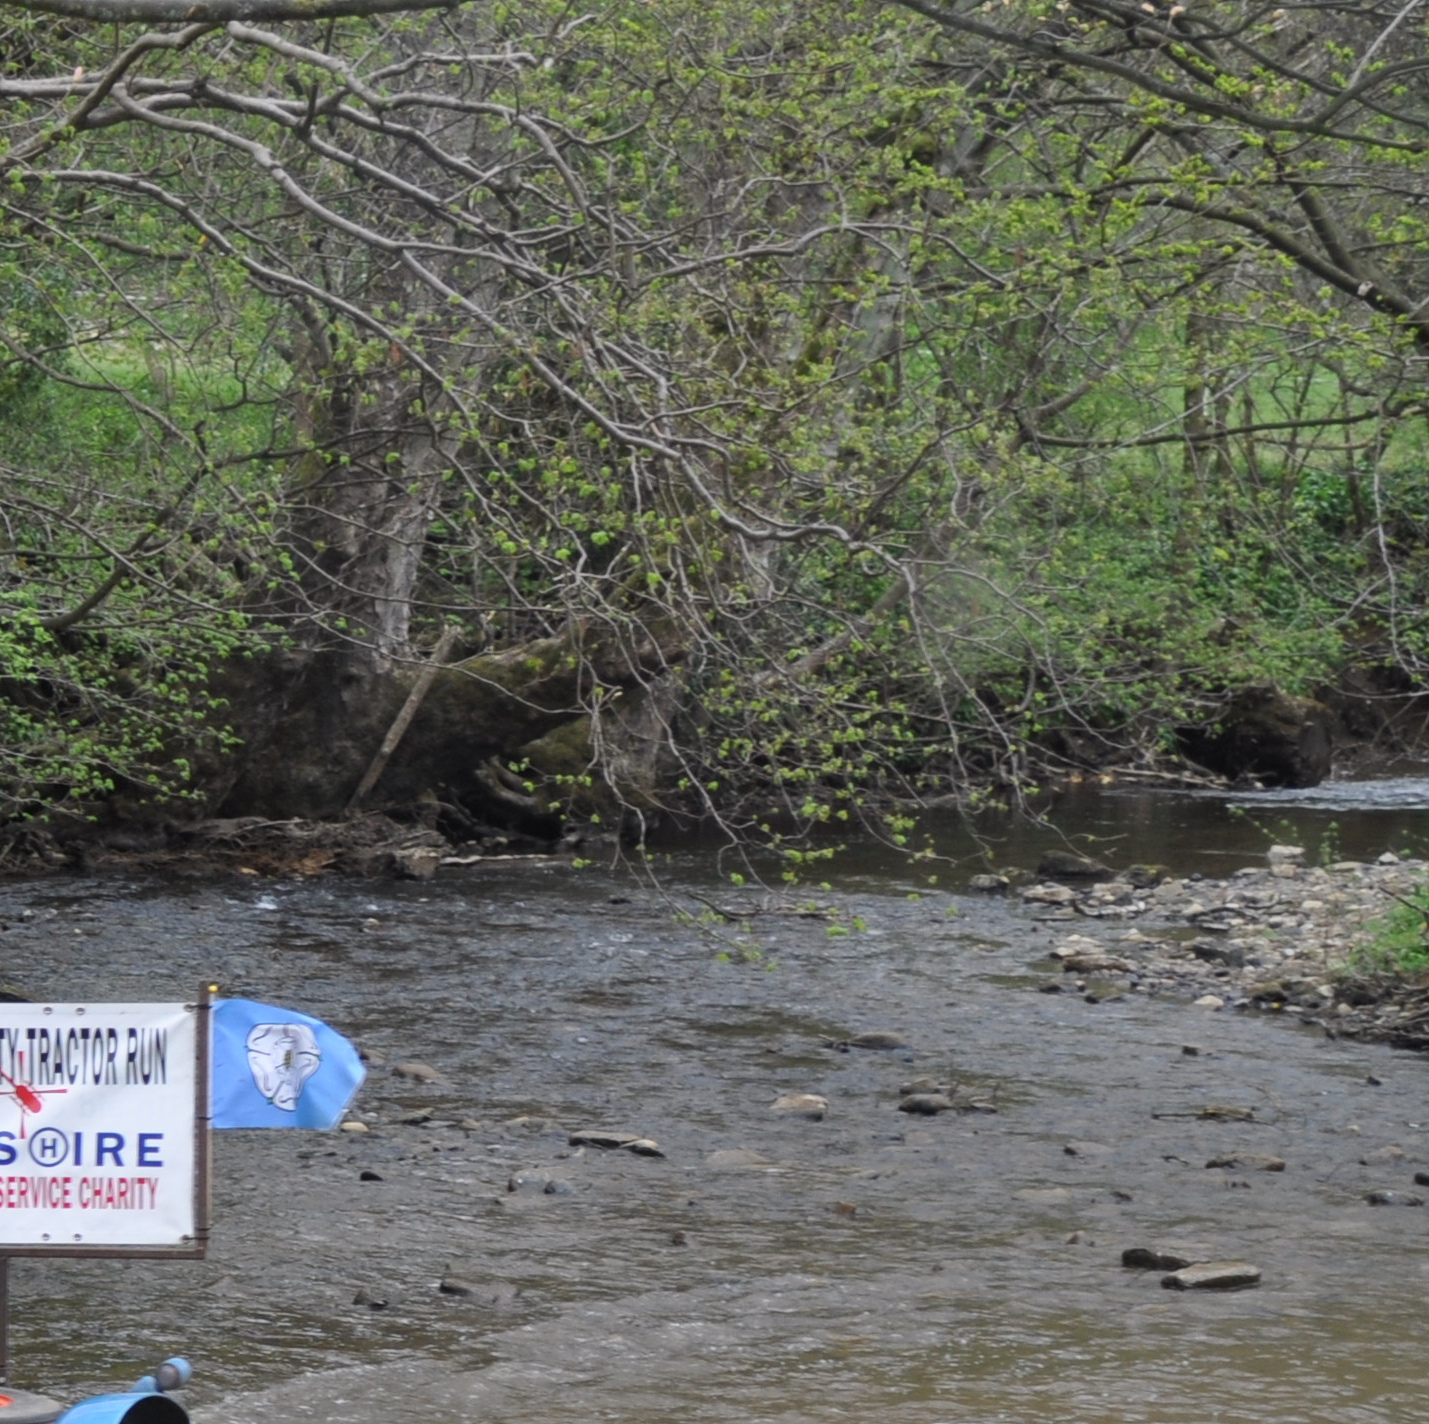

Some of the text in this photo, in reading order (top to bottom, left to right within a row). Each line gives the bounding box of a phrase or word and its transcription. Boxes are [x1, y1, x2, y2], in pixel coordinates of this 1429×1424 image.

[27, 1027, 118, 1085] TRACTOR
[126, 1027, 167, 1085] RUN
[79, 1177, 159, 1210] CHARITY
